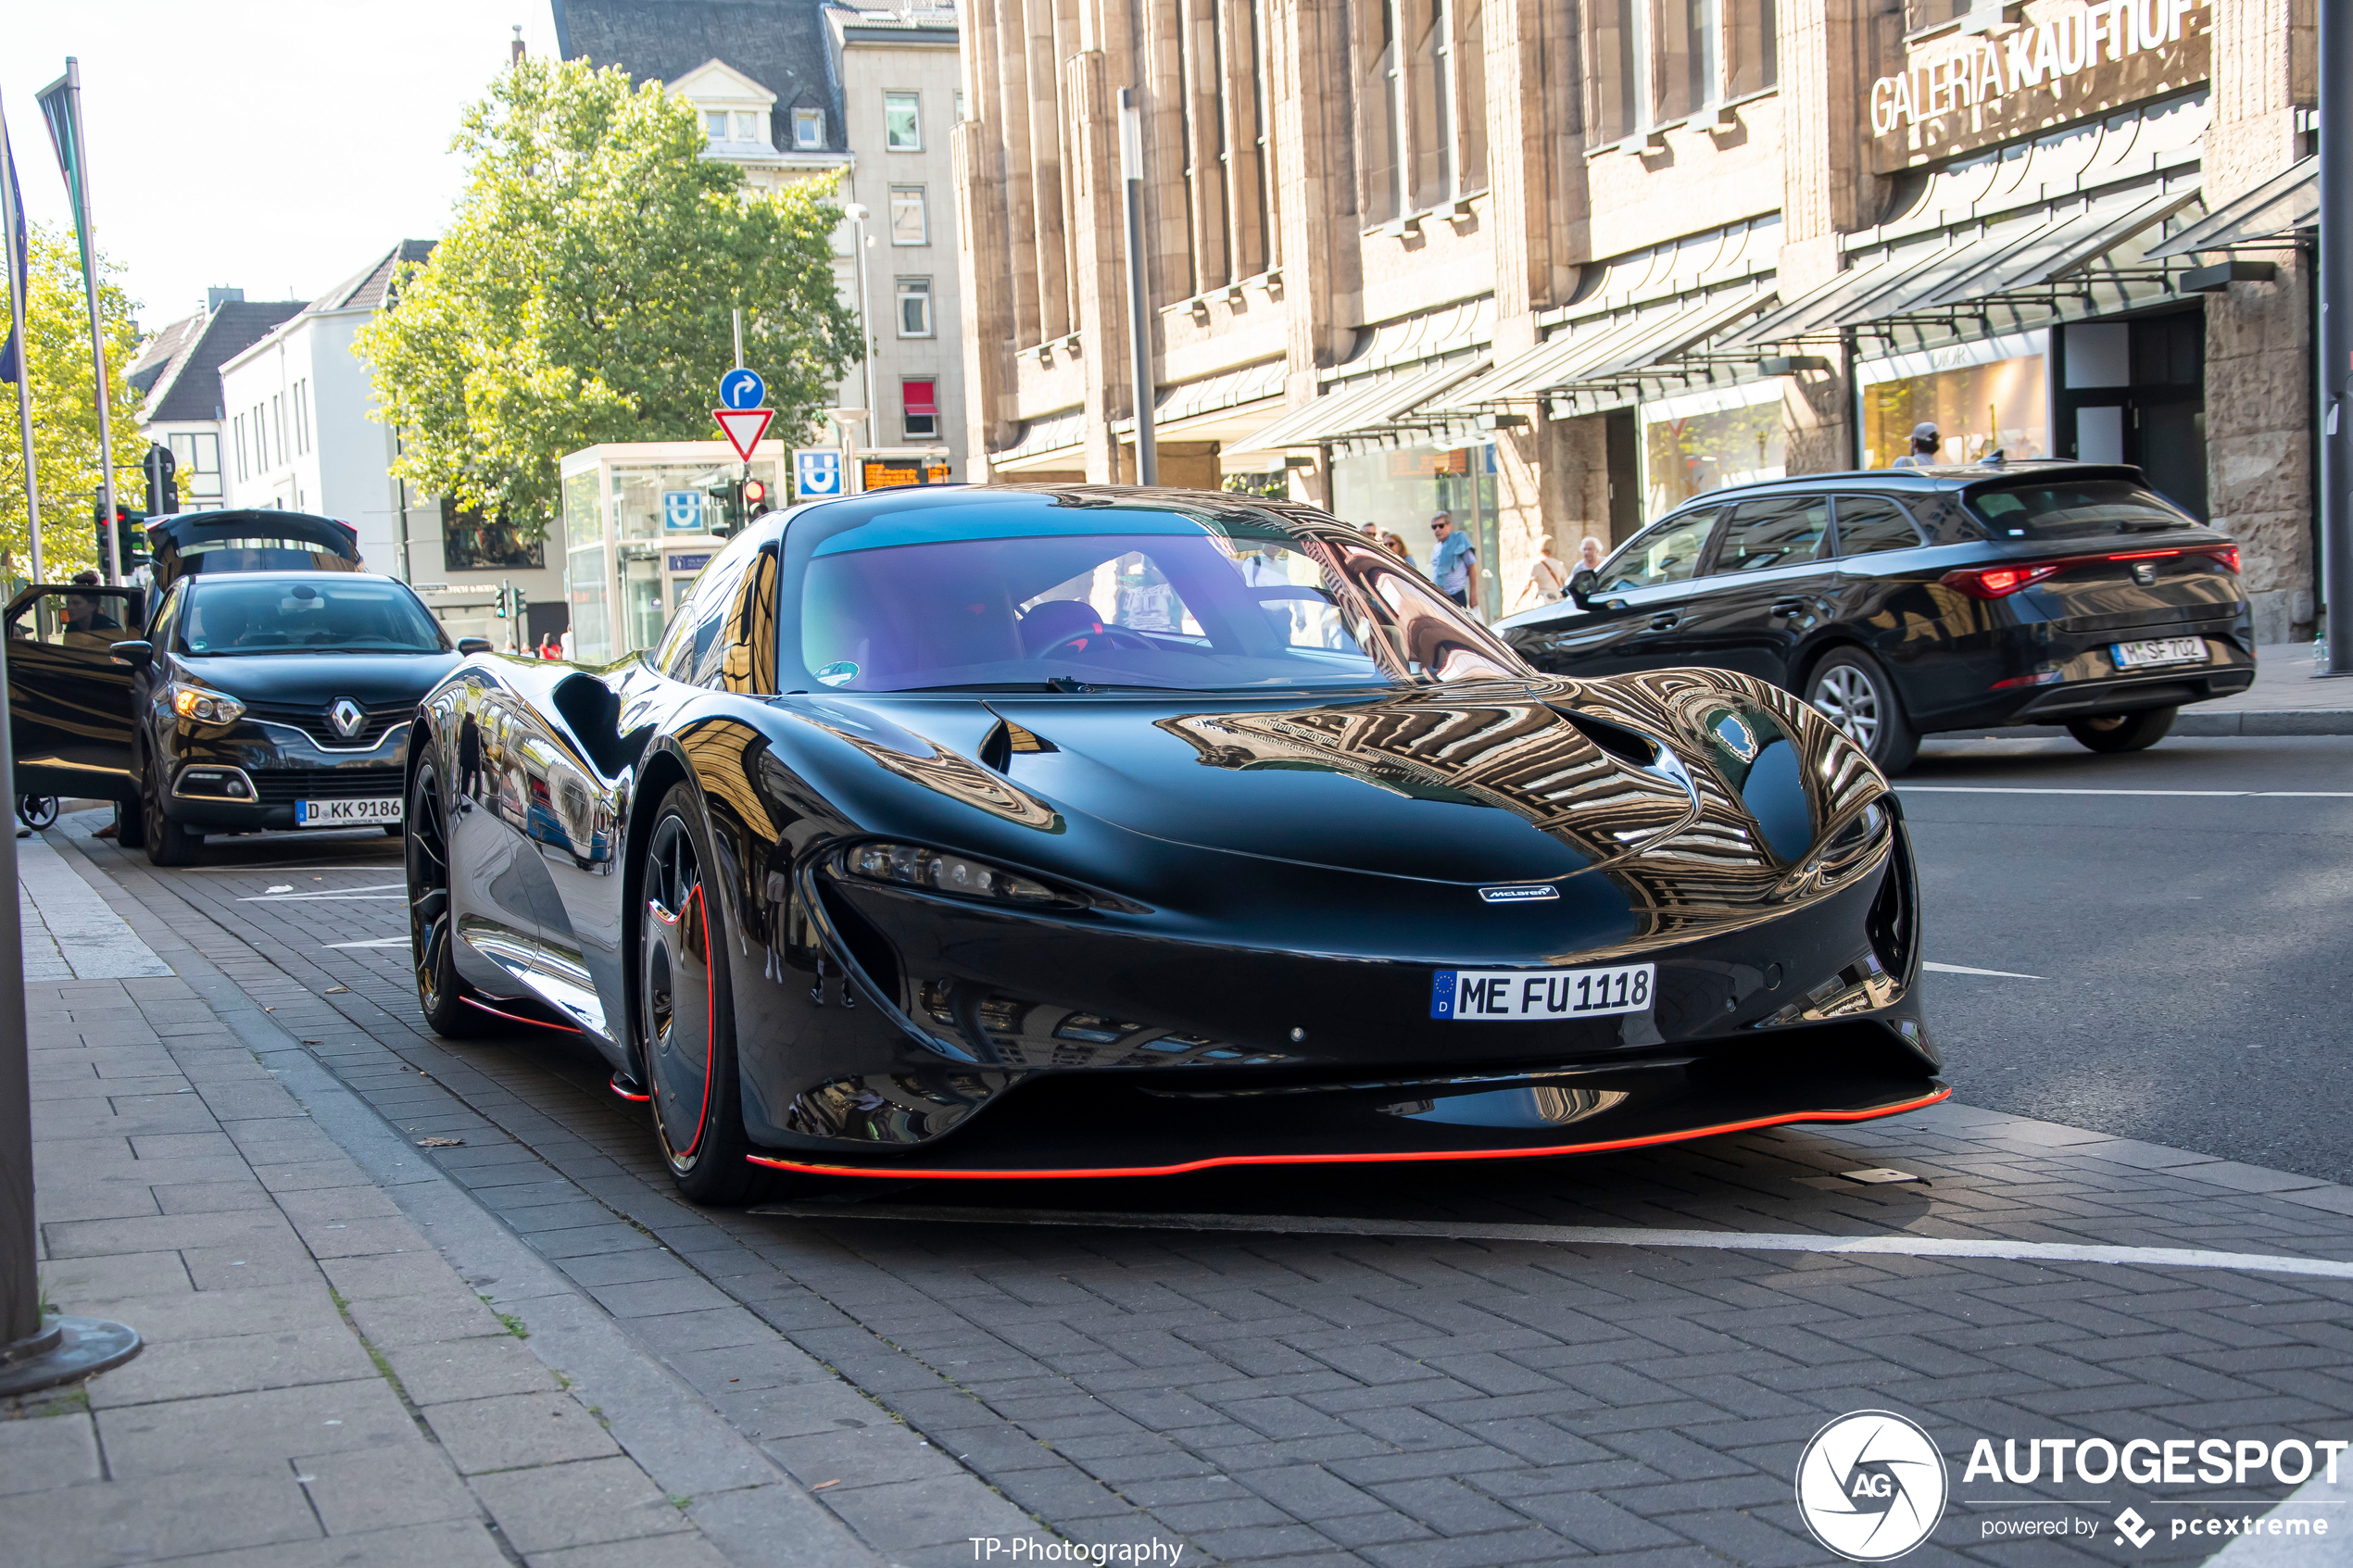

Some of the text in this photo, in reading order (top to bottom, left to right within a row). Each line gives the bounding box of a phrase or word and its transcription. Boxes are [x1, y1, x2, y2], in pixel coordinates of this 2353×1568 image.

[1870, 41, 2004, 135] GALERIA
[1931, 347, 1966, 369] DIOR
[804, 455, 835, 493] U
[670, 495, 696, 526] U
[2146, 642, 2166, 659] SF
[2168, 639, 2198, 657] 702
[831, 663, 842, 674] 4
[308, 800, 400, 819] D KK 9186
[1439, 1001, 1448, 1012] D
[1459, 978, 1510, 1013] ME
